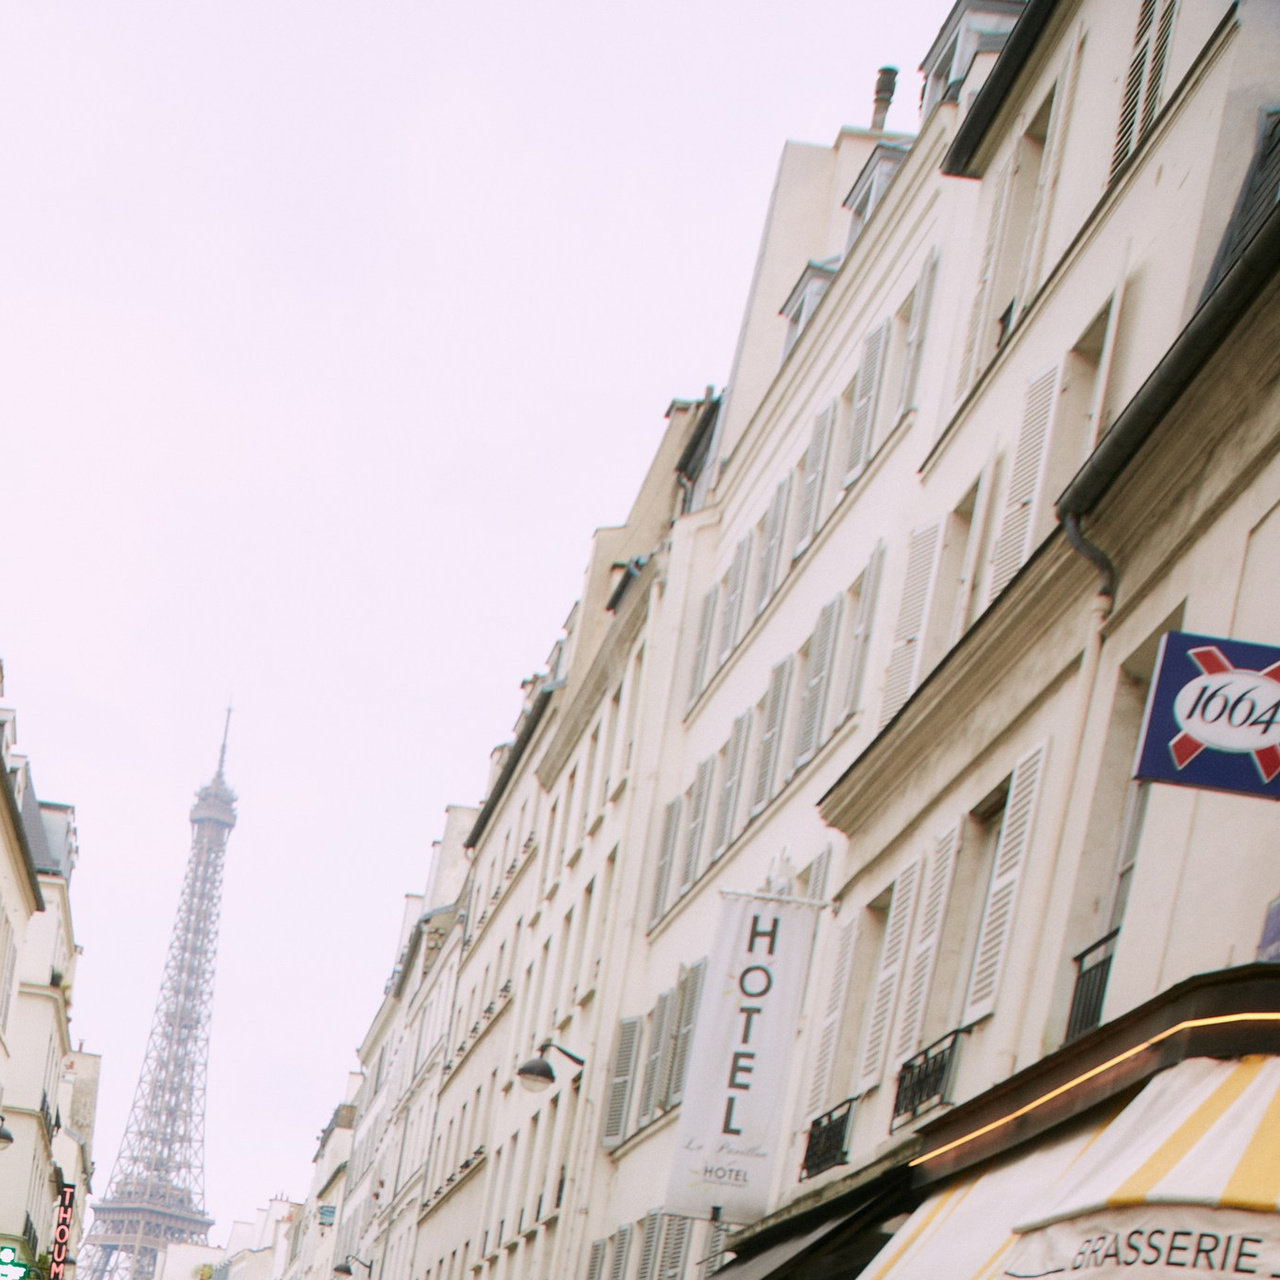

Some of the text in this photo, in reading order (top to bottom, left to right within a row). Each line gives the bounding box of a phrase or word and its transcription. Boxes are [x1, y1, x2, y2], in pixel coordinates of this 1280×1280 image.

[1186, 681, 1280, 735] 1664
[722, 914, 780, 1136] HOTEL
[703, 1165, 747, 1182] HOTEL
[1072, 1229, 1264, 1274] BRASSERIE
